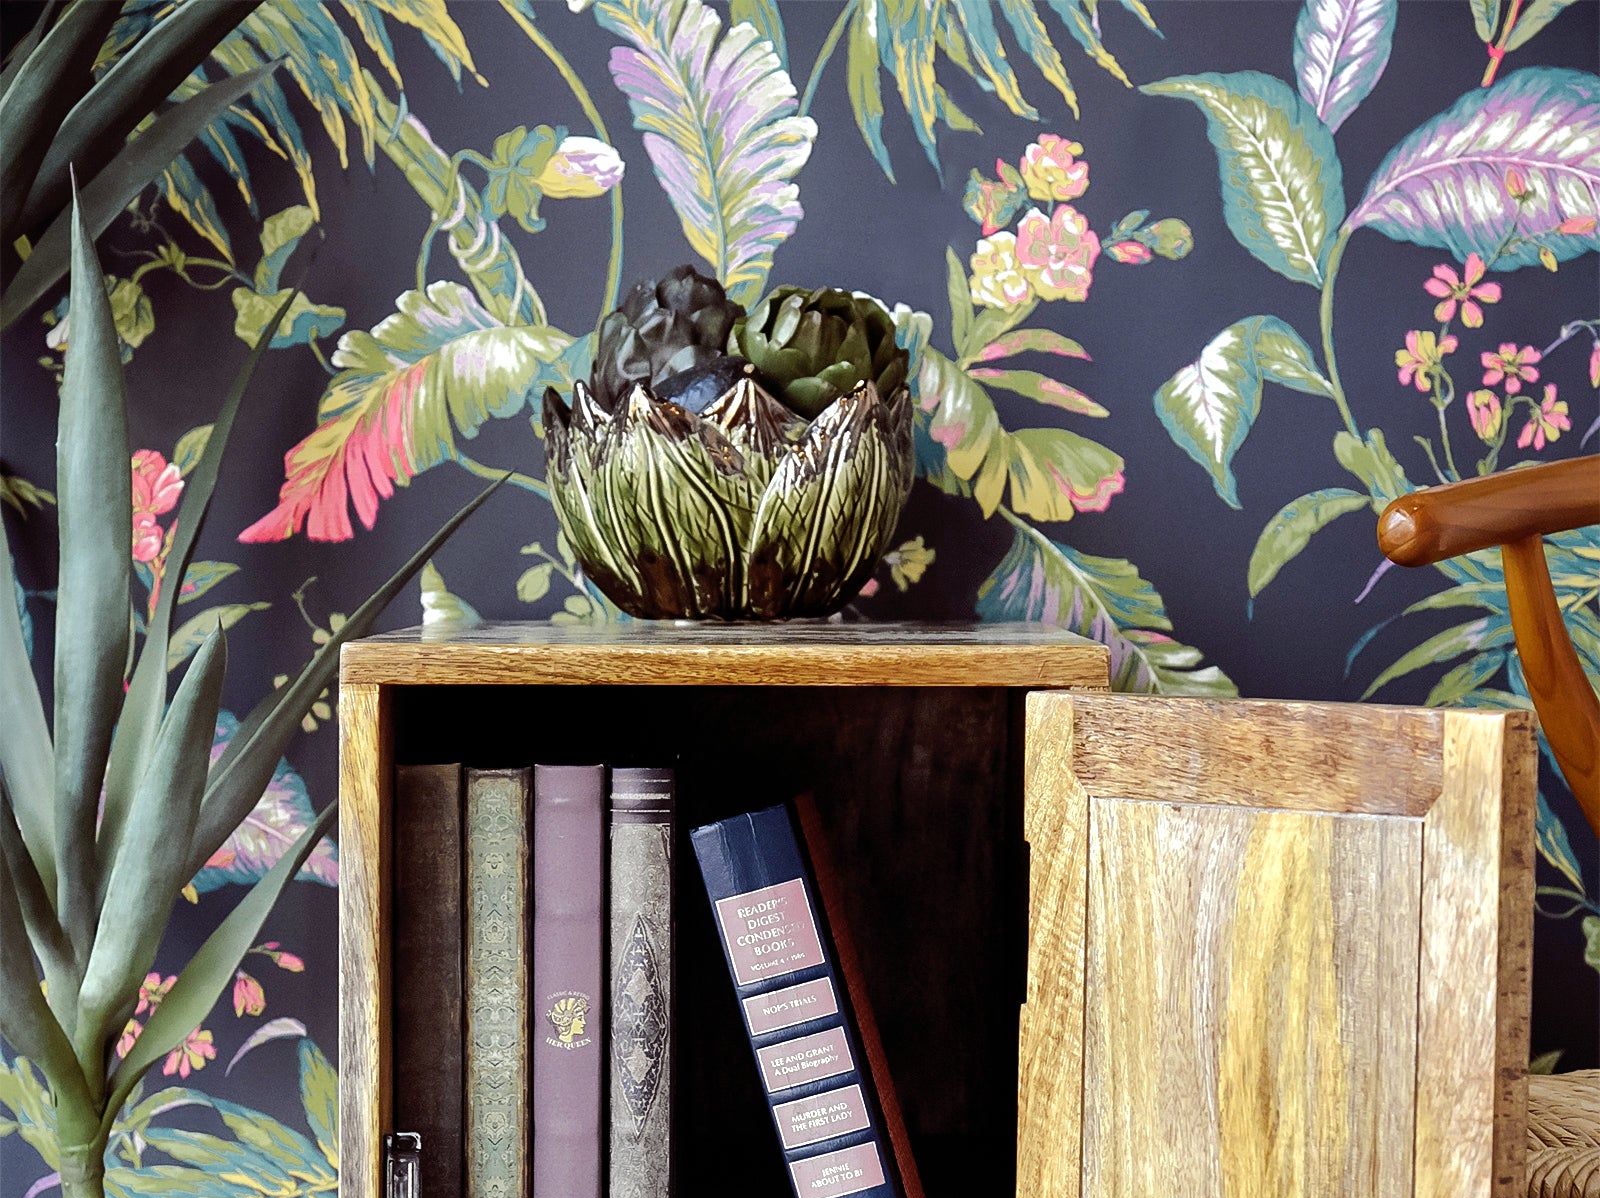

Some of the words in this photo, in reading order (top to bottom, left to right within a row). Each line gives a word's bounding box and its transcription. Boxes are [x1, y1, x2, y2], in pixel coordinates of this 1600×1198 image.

[747, 911, 785, 930] DIGEST
[736, 922, 805, 947] CONDENS
[790, 995, 817, 1011] TRIALS
[545, 1036, 563, 1049] HER
[563, 1036, 592, 1051] QUEEN
[770, 1057, 785, 1068] LEE
[786, 1052, 805, 1064] AND
[806, 1045, 834, 1058] GRANT
[774, 1068, 781, 1076] A
[782, 1063, 801, 1075] Dual
[801, 1054, 839, 1070] Biography
[791, 1107, 827, 1123] MURDER
[828, 1102, 848, 1113] AND
[791, 1122, 808, 1133] THE
[808, 1117, 830, 1129] FIRST
[831, 1110, 853, 1123] LADY
[822, 1162, 850, 1177] JENNIE
[811, 1174, 840, 1189] ABOUT
[840, 1171, 854, 1181] TO
